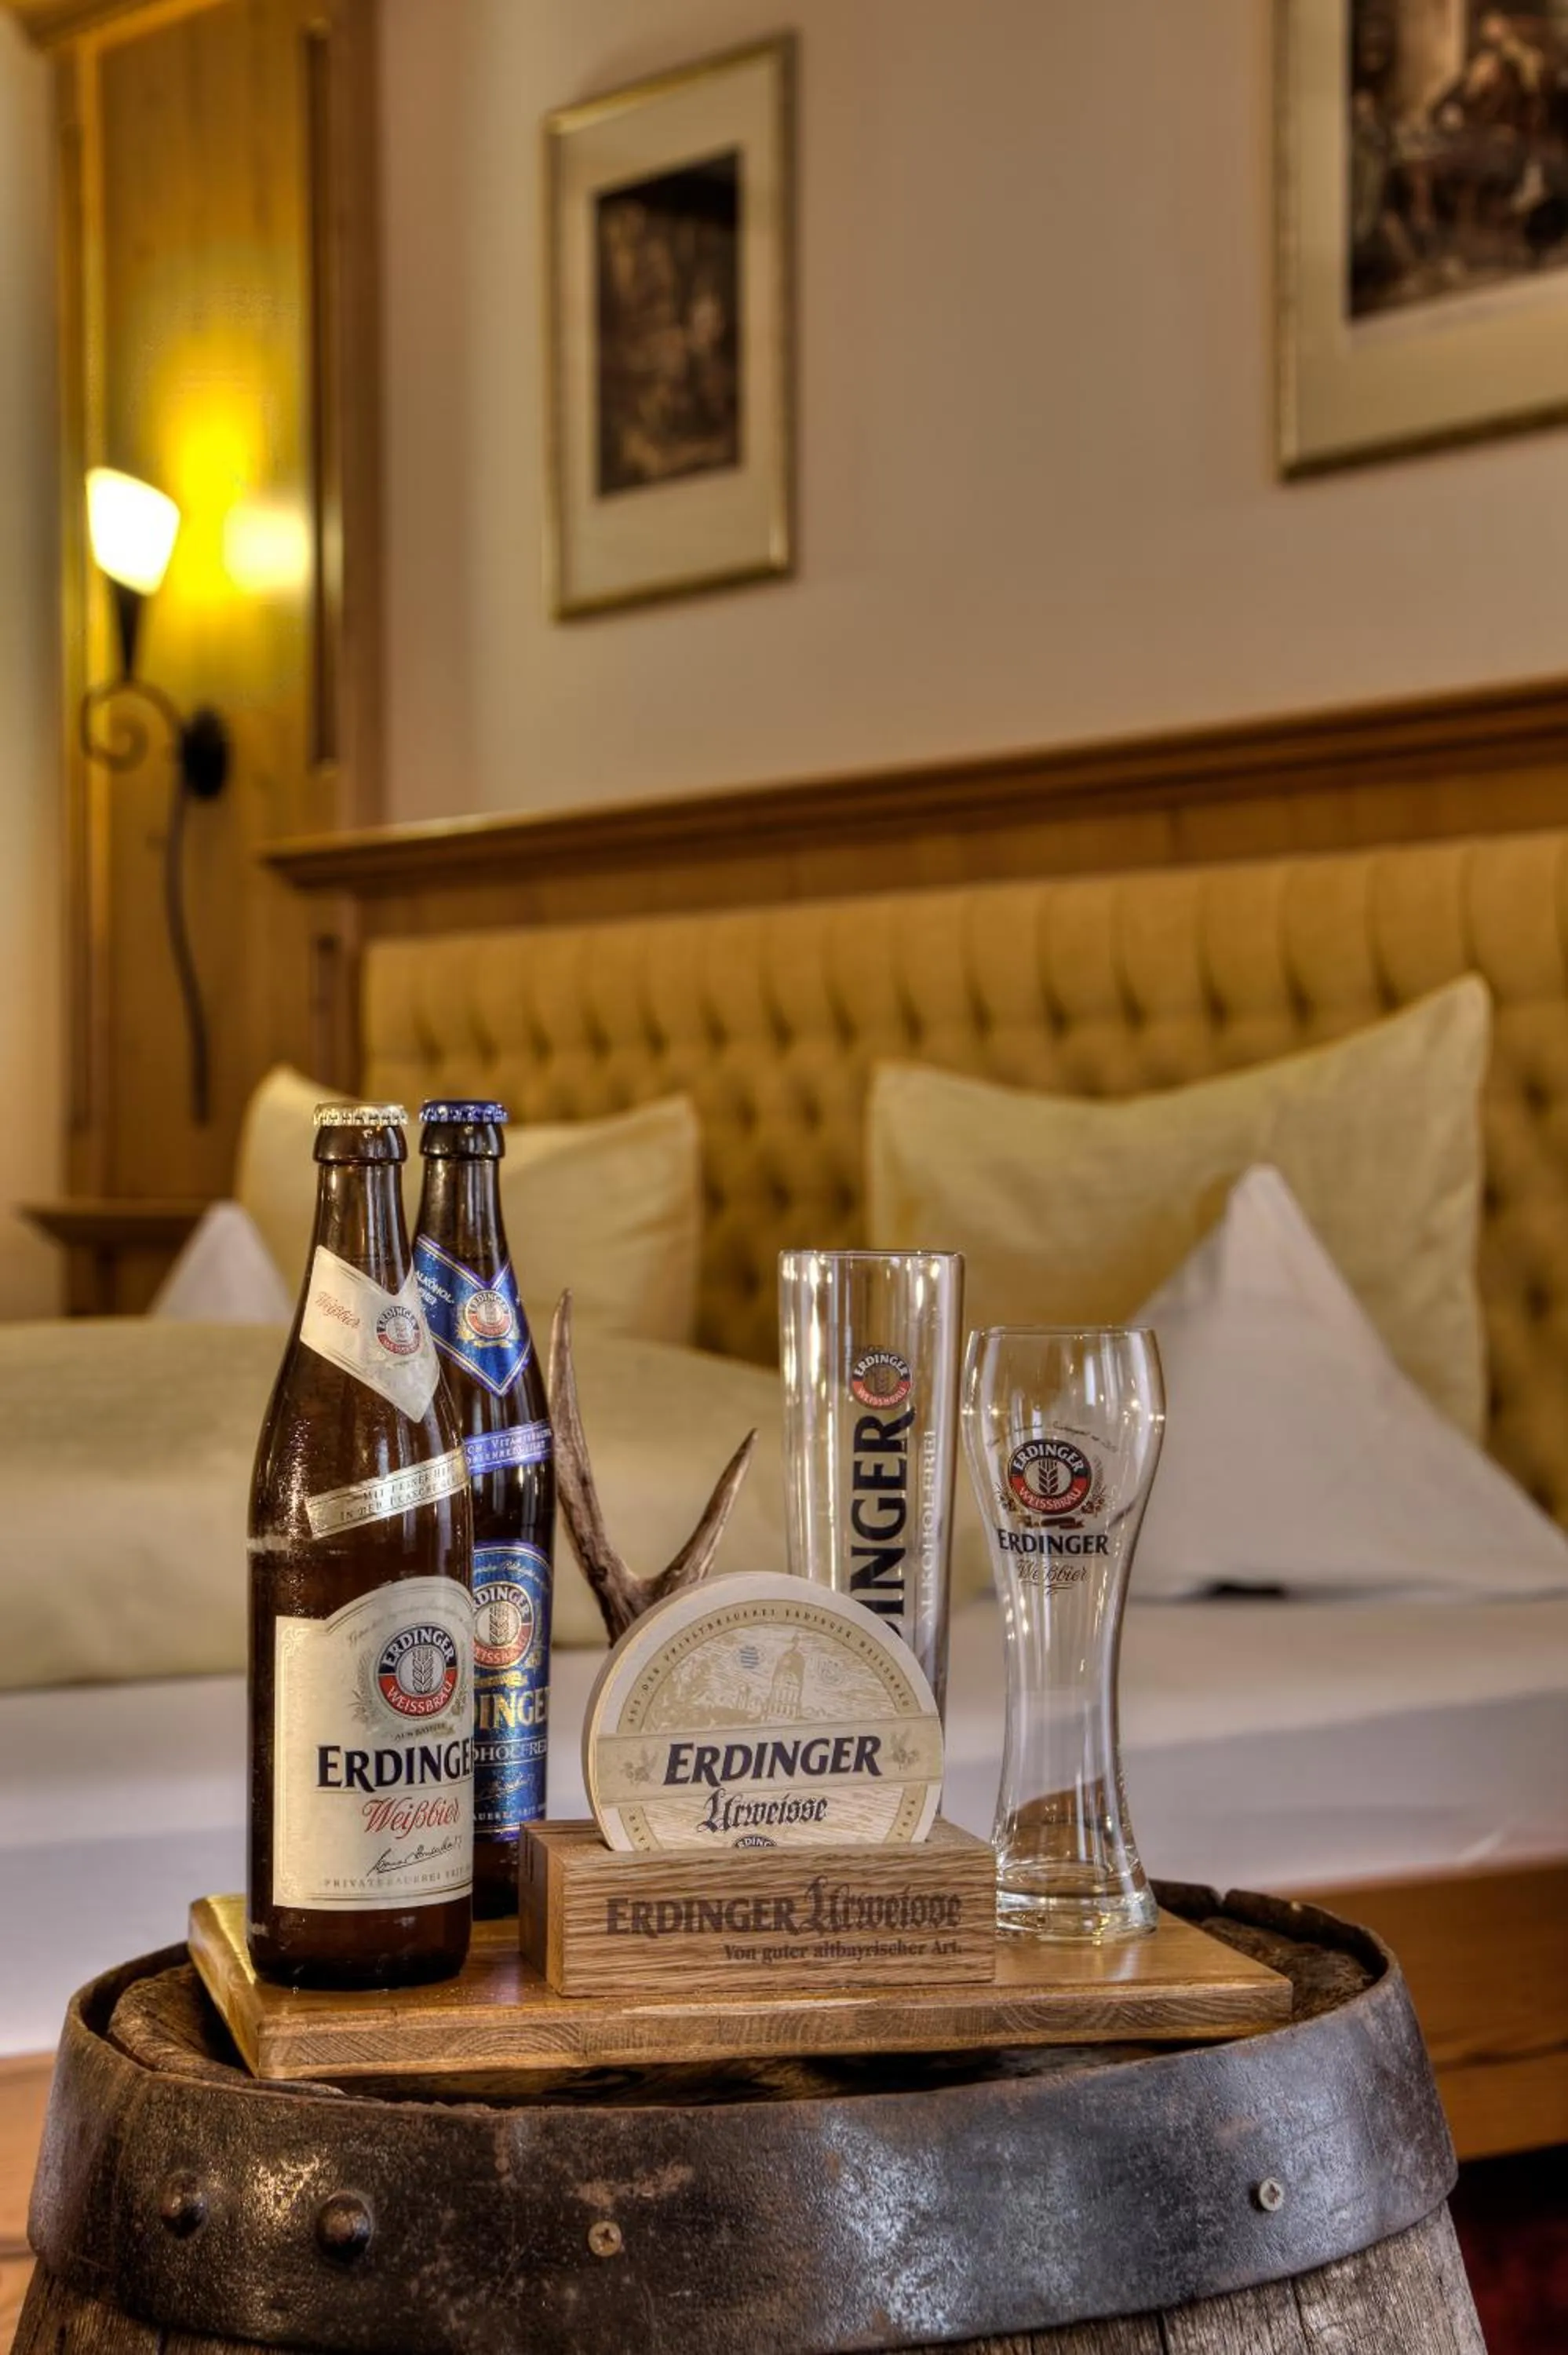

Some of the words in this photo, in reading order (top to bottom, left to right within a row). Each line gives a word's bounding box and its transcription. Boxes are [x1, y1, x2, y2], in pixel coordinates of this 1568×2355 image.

[854, 1354, 908, 1377] ERDINGER
[1012, 1444, 1085, 1471] ERDINGER
[850, 1406, 916, 1638] INGER
[997, 1528, 1109, 1555] ERDINGER
[381, 1627, 455, 1668] ERDINGER
[472, 1688, 549, 1729] INGE
[317, 1736, 473, 1794] ERDINGE
[662, 1735, 883, 1787] ERDINGER
[362, 1797, 460, 1839] Weißbier
[696, 1787, 829, 1835] Urweisse
[607, 1897, 800, 1939] ERDINGER
[799, 1875, 963, 1937] Urweisse
[722, 1944, 756, 1962] Von
[760, 1943, 809, 1963] guter
[813, 1938, 925, 1962] altbayrischer
[930, 1937, 963, 1955] Art.
